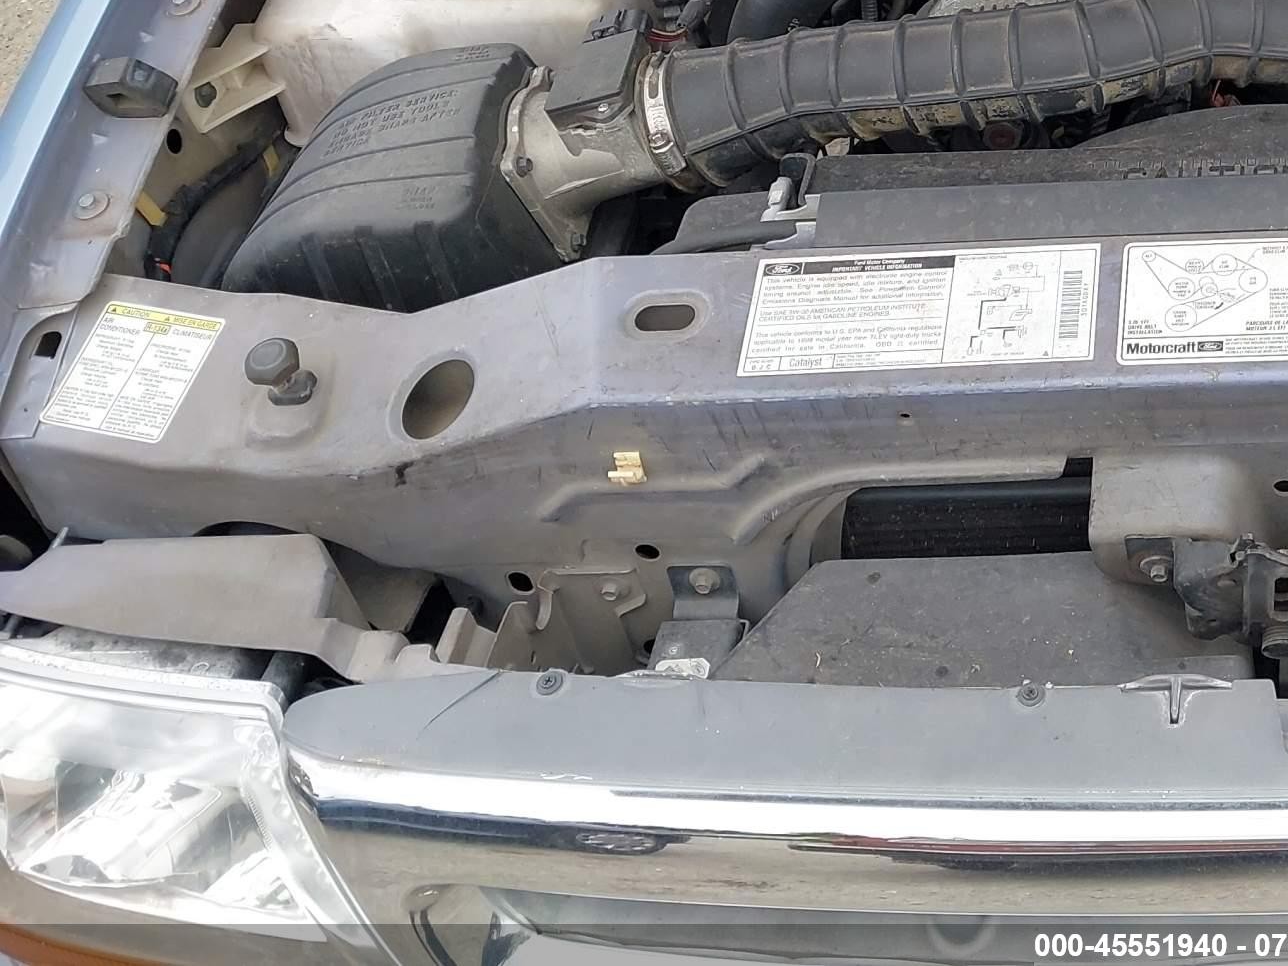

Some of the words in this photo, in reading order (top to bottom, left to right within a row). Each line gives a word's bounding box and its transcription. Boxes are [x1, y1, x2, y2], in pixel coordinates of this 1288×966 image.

[122, 308, 150, 318] CAUTION
[99, 324, 141, 336] CONDITIONER
[172, 329, 213, 340] CLIMATISEUR
[1128, 341, 1195, 354] Motorcraft
[789, 357, 823, 368] Catalyst
